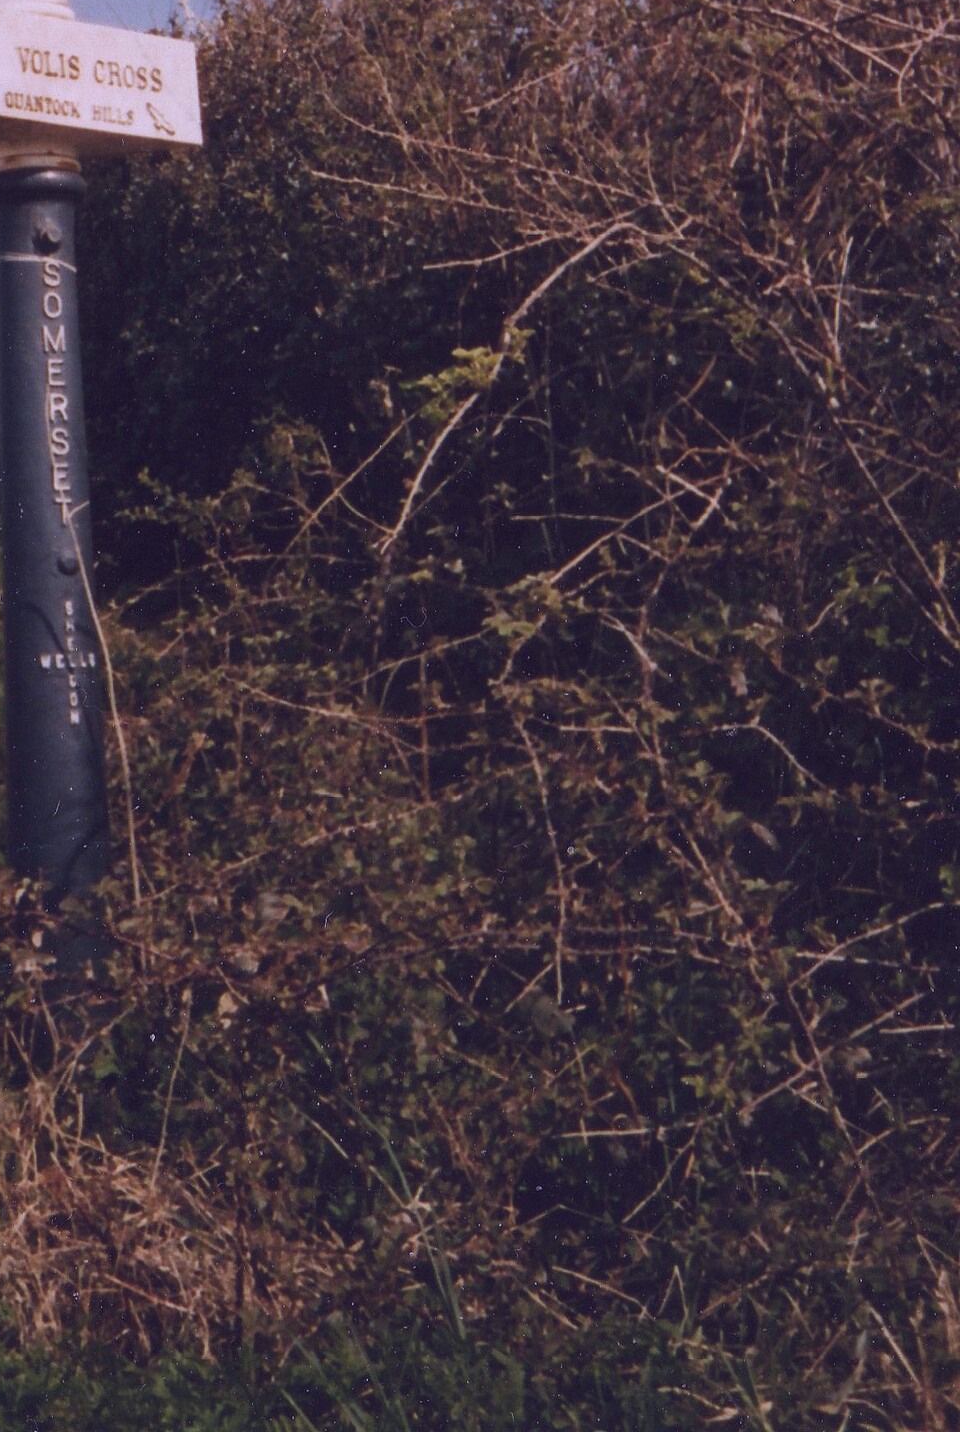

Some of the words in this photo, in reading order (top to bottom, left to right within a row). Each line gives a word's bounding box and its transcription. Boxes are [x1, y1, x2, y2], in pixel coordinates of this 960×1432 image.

[16, 47, 80, 80] VOLIS
[94, 59, 163, 93] CROSS
[4, 91, 80, 118] QUANTOCK
[92, 104, 135, 126] HILLS
[43, 262, 72, 525] SOMERSET
